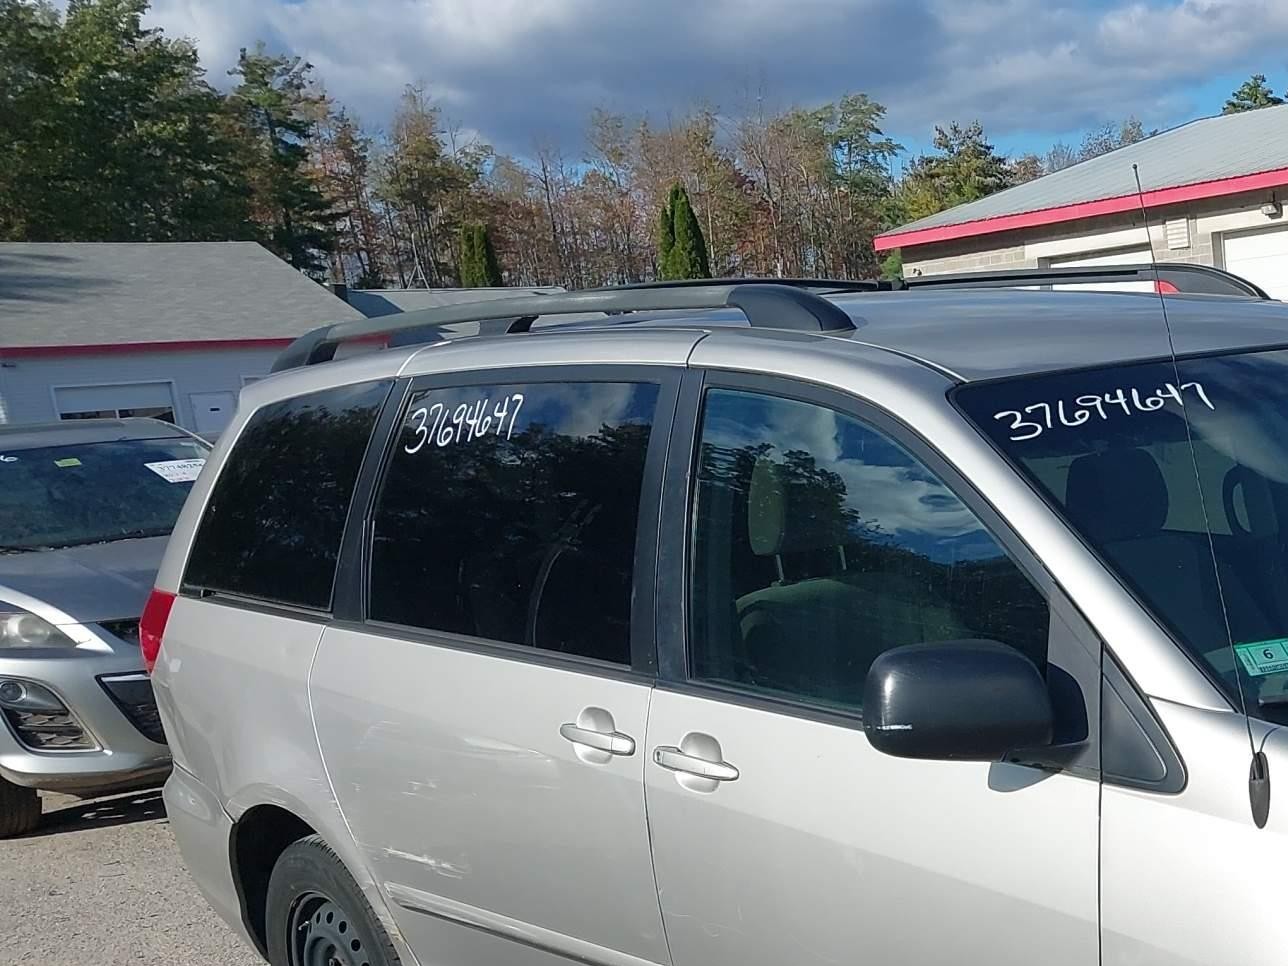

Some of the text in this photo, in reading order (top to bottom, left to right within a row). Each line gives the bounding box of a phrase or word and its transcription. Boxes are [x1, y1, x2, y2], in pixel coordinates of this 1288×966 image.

[404, 393, 524, 454] 37694647
[993, 382, 1215, 441] 37694647
[1263, 648, 1274, 660] 6
